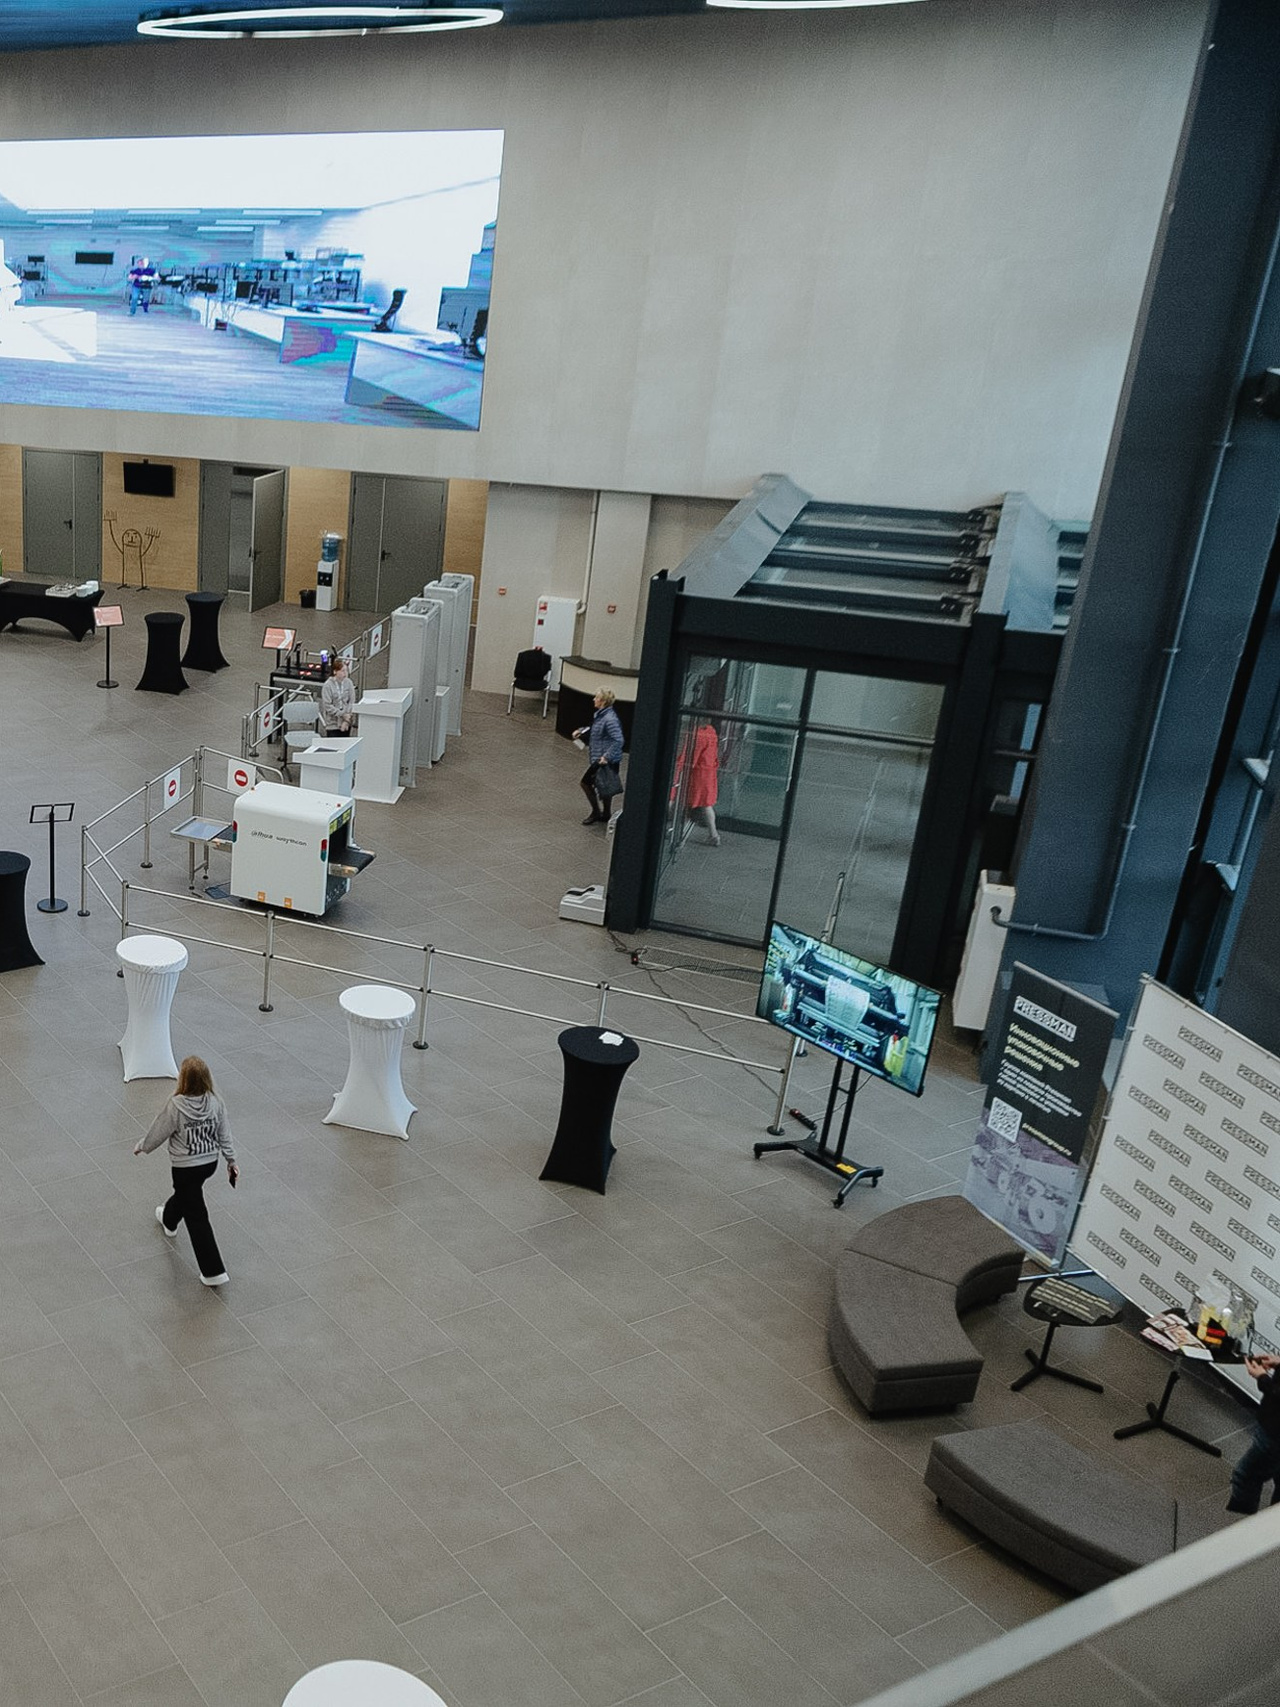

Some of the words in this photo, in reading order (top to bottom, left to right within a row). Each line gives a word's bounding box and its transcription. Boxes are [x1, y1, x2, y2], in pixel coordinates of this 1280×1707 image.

[1014, 997, 1076, 1041] PRESSMAN
[1129, 1086, 1170, 1120] PRESSMAN
[1163, 1079, 1207, 1115] PRESSMAN
[1199, 1072, 1245, 1108] PRESSMAN
[1115, 1136, 1155, 1171] PRESSMAN
[1148, 1131, 1191, 1166] PRESSMAN
[1184, 1124, 1229, 1161] PRESSMAN
[1222, 1118, 1268, 1156] PRESSMAN
[1100, 1185, 1141, 1220] PRESSMAN
[1134, 1180, 1176, 1217] PRESSMAN
[1169, 1176, 1213, 1213] PRESSMAN
[1205, 1170, 1252, 1209] PRESSMAN
[1087, 1232, 1127, 1268] PRESSMAN
[1120, 1228, 1161, 1266] PRESSMAN
[1154, 1226, 1197, 1264] PRESSMAN
[1190, 1222, 1236, 1261] PRESSMAN
[1228, 1218, 1276, 1259] PRESSMAN
